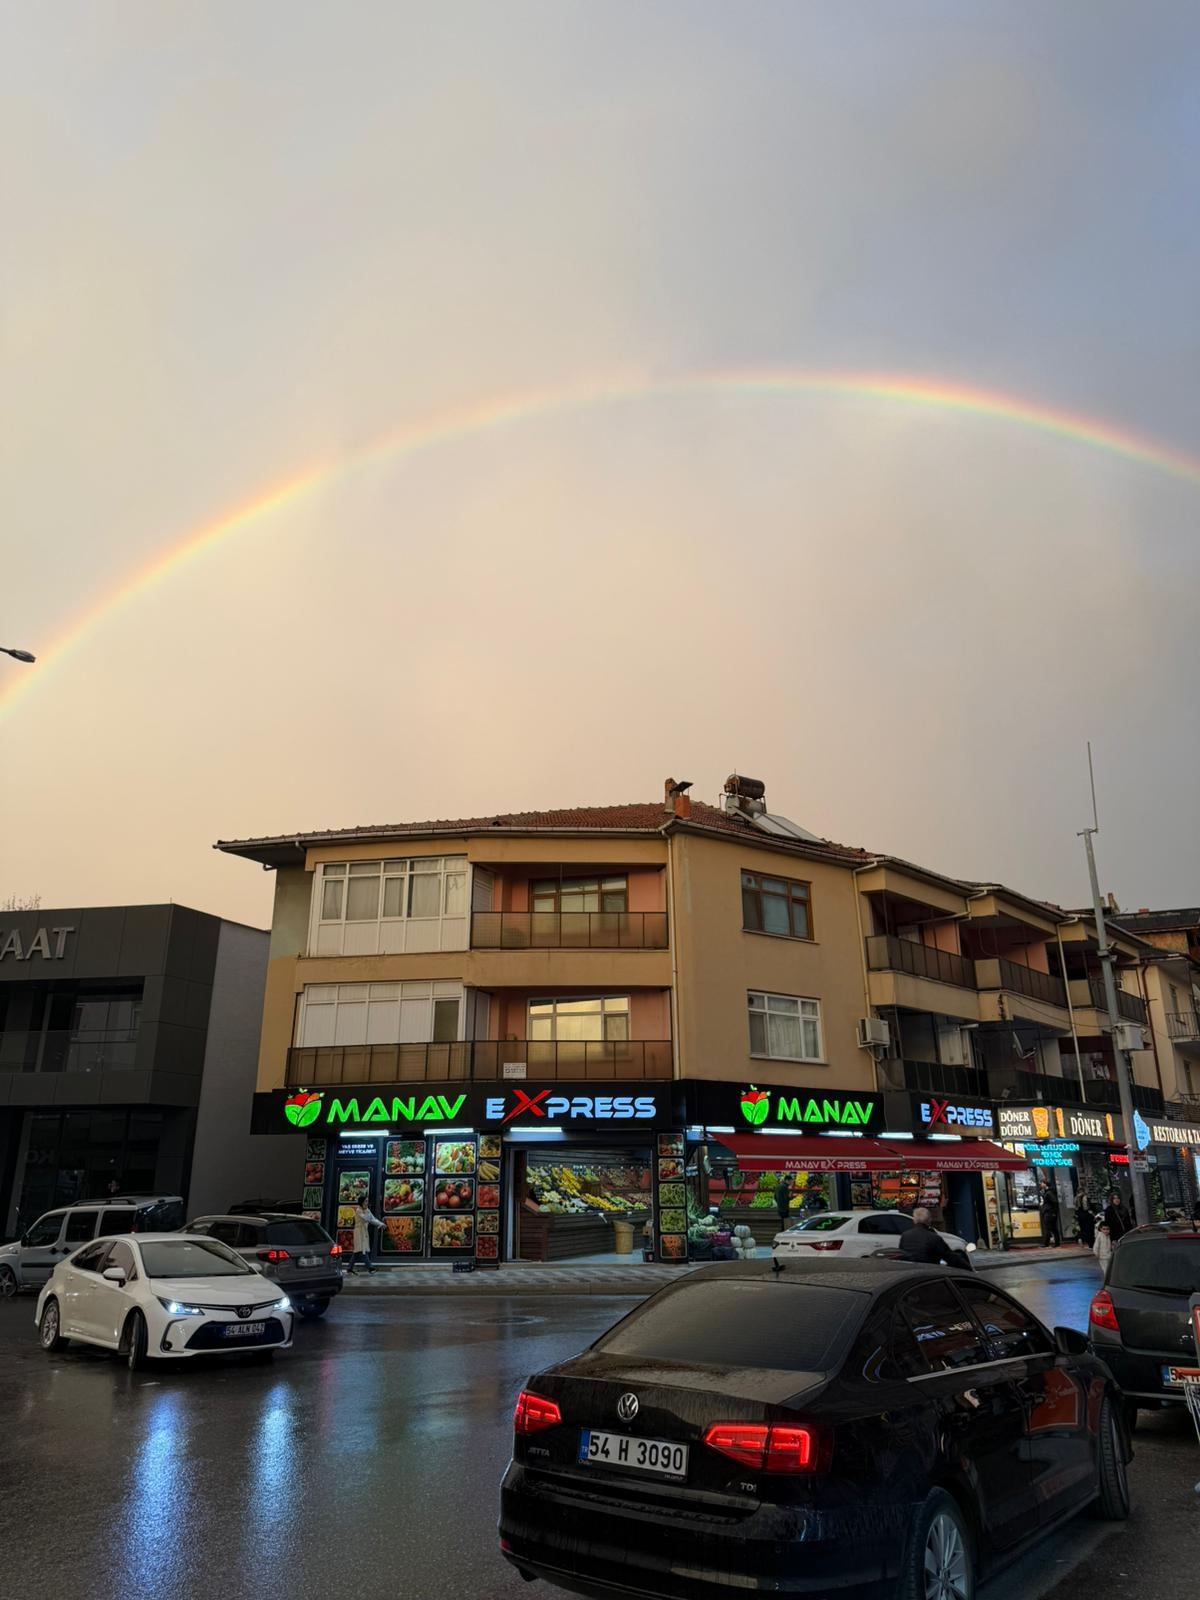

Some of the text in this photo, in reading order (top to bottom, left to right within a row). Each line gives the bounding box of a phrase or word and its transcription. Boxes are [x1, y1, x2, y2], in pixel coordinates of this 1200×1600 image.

[0, 926, 75, 960] AAT
[327, 1089, 657, 1125] MANAV EXPRESS
[777, 1096, 874, 1125] MANAV
[920, 1098, 993, 1128] EXPRESS
[1001, 1110, 1030, 1122] DÖNER
[1001, 1124, 1032, 1136] DÜRÜM
[1070, 1112, 1103, 1136] DÖNER
[1153, 1125, 1188, 1143] RESTORAN
[785, 1160, 819, 1169] MANAV
[936, 1160, 963, 1168] MANAV
[528, 1446, 550, 1457] JETTA
[589, 1434, 610, 1459] 54
[618, 1438, 630, 1462] H
[637, 1441, 683, 1471] 3090
